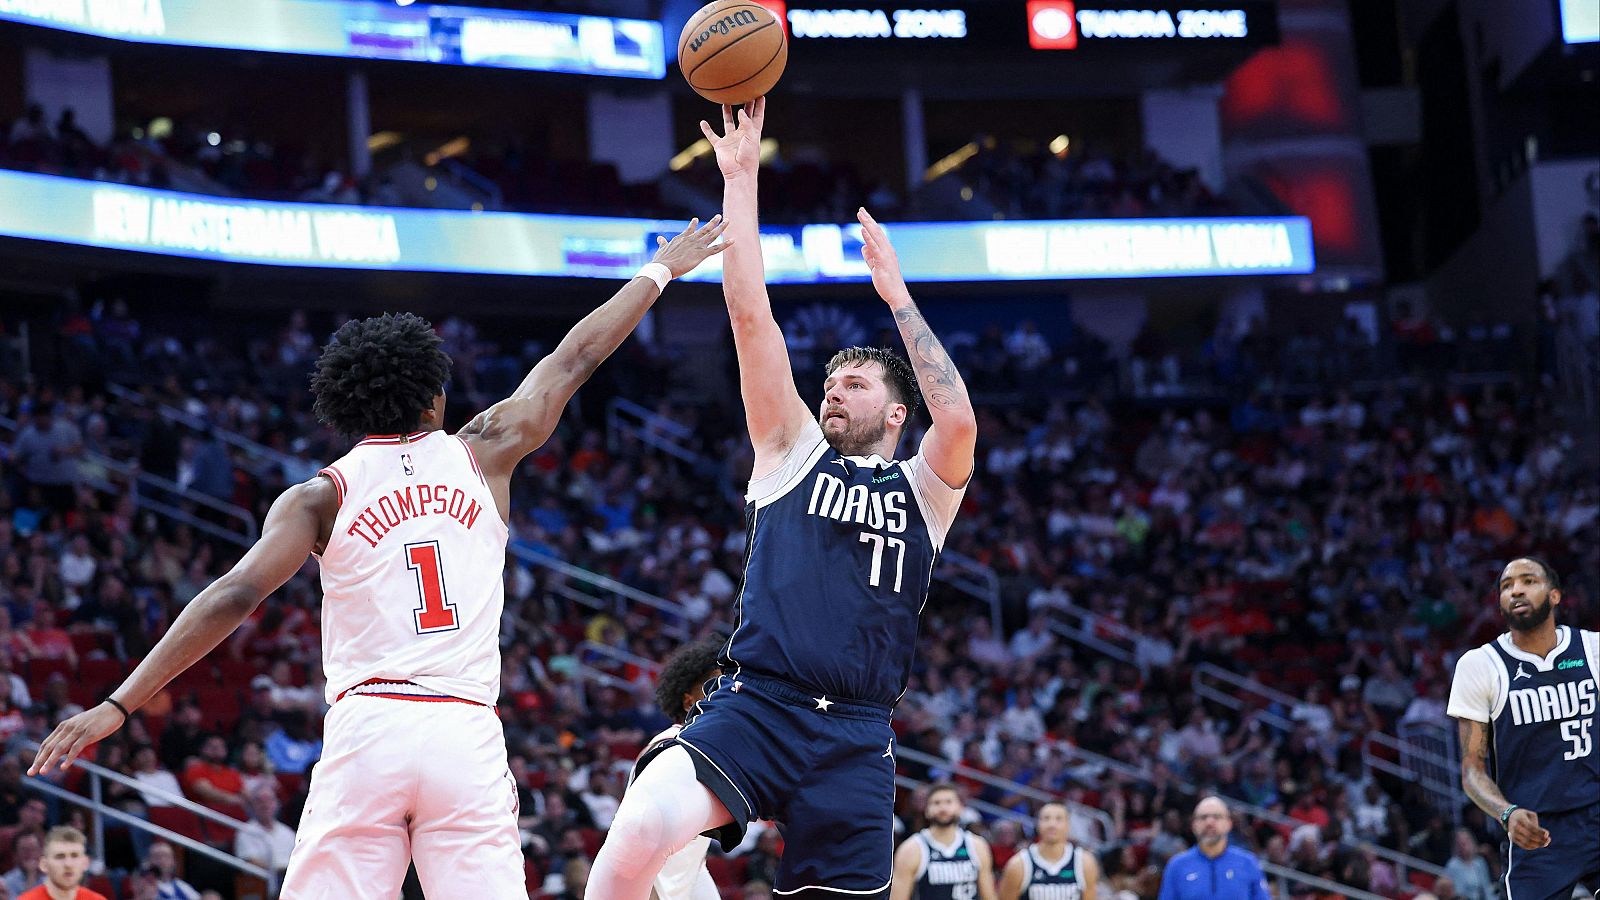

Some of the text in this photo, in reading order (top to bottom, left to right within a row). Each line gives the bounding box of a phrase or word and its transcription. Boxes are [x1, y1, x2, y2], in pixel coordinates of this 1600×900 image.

[689, 9, 758, 53] Wilson
[787, 9, 967, 38] TUNDRA ZONE
[1076, 9, 1248, 38] TUNDRA ZONE
[93, 189, 401, 263] NEW AMSTERDAM VODKA
[871, 472, 899, 484] hime
[347, 484, 482, 548] THOMPSON
[807, 472, 907, 533] MAVS
[859, 531, 906, 593] 77
[404, 540, 460, 635] 1
[1557, 659, 1585, 670] chime
[1508, 678, 1596, 726] MAVS
[1560, 718, 1593, 760] 55
